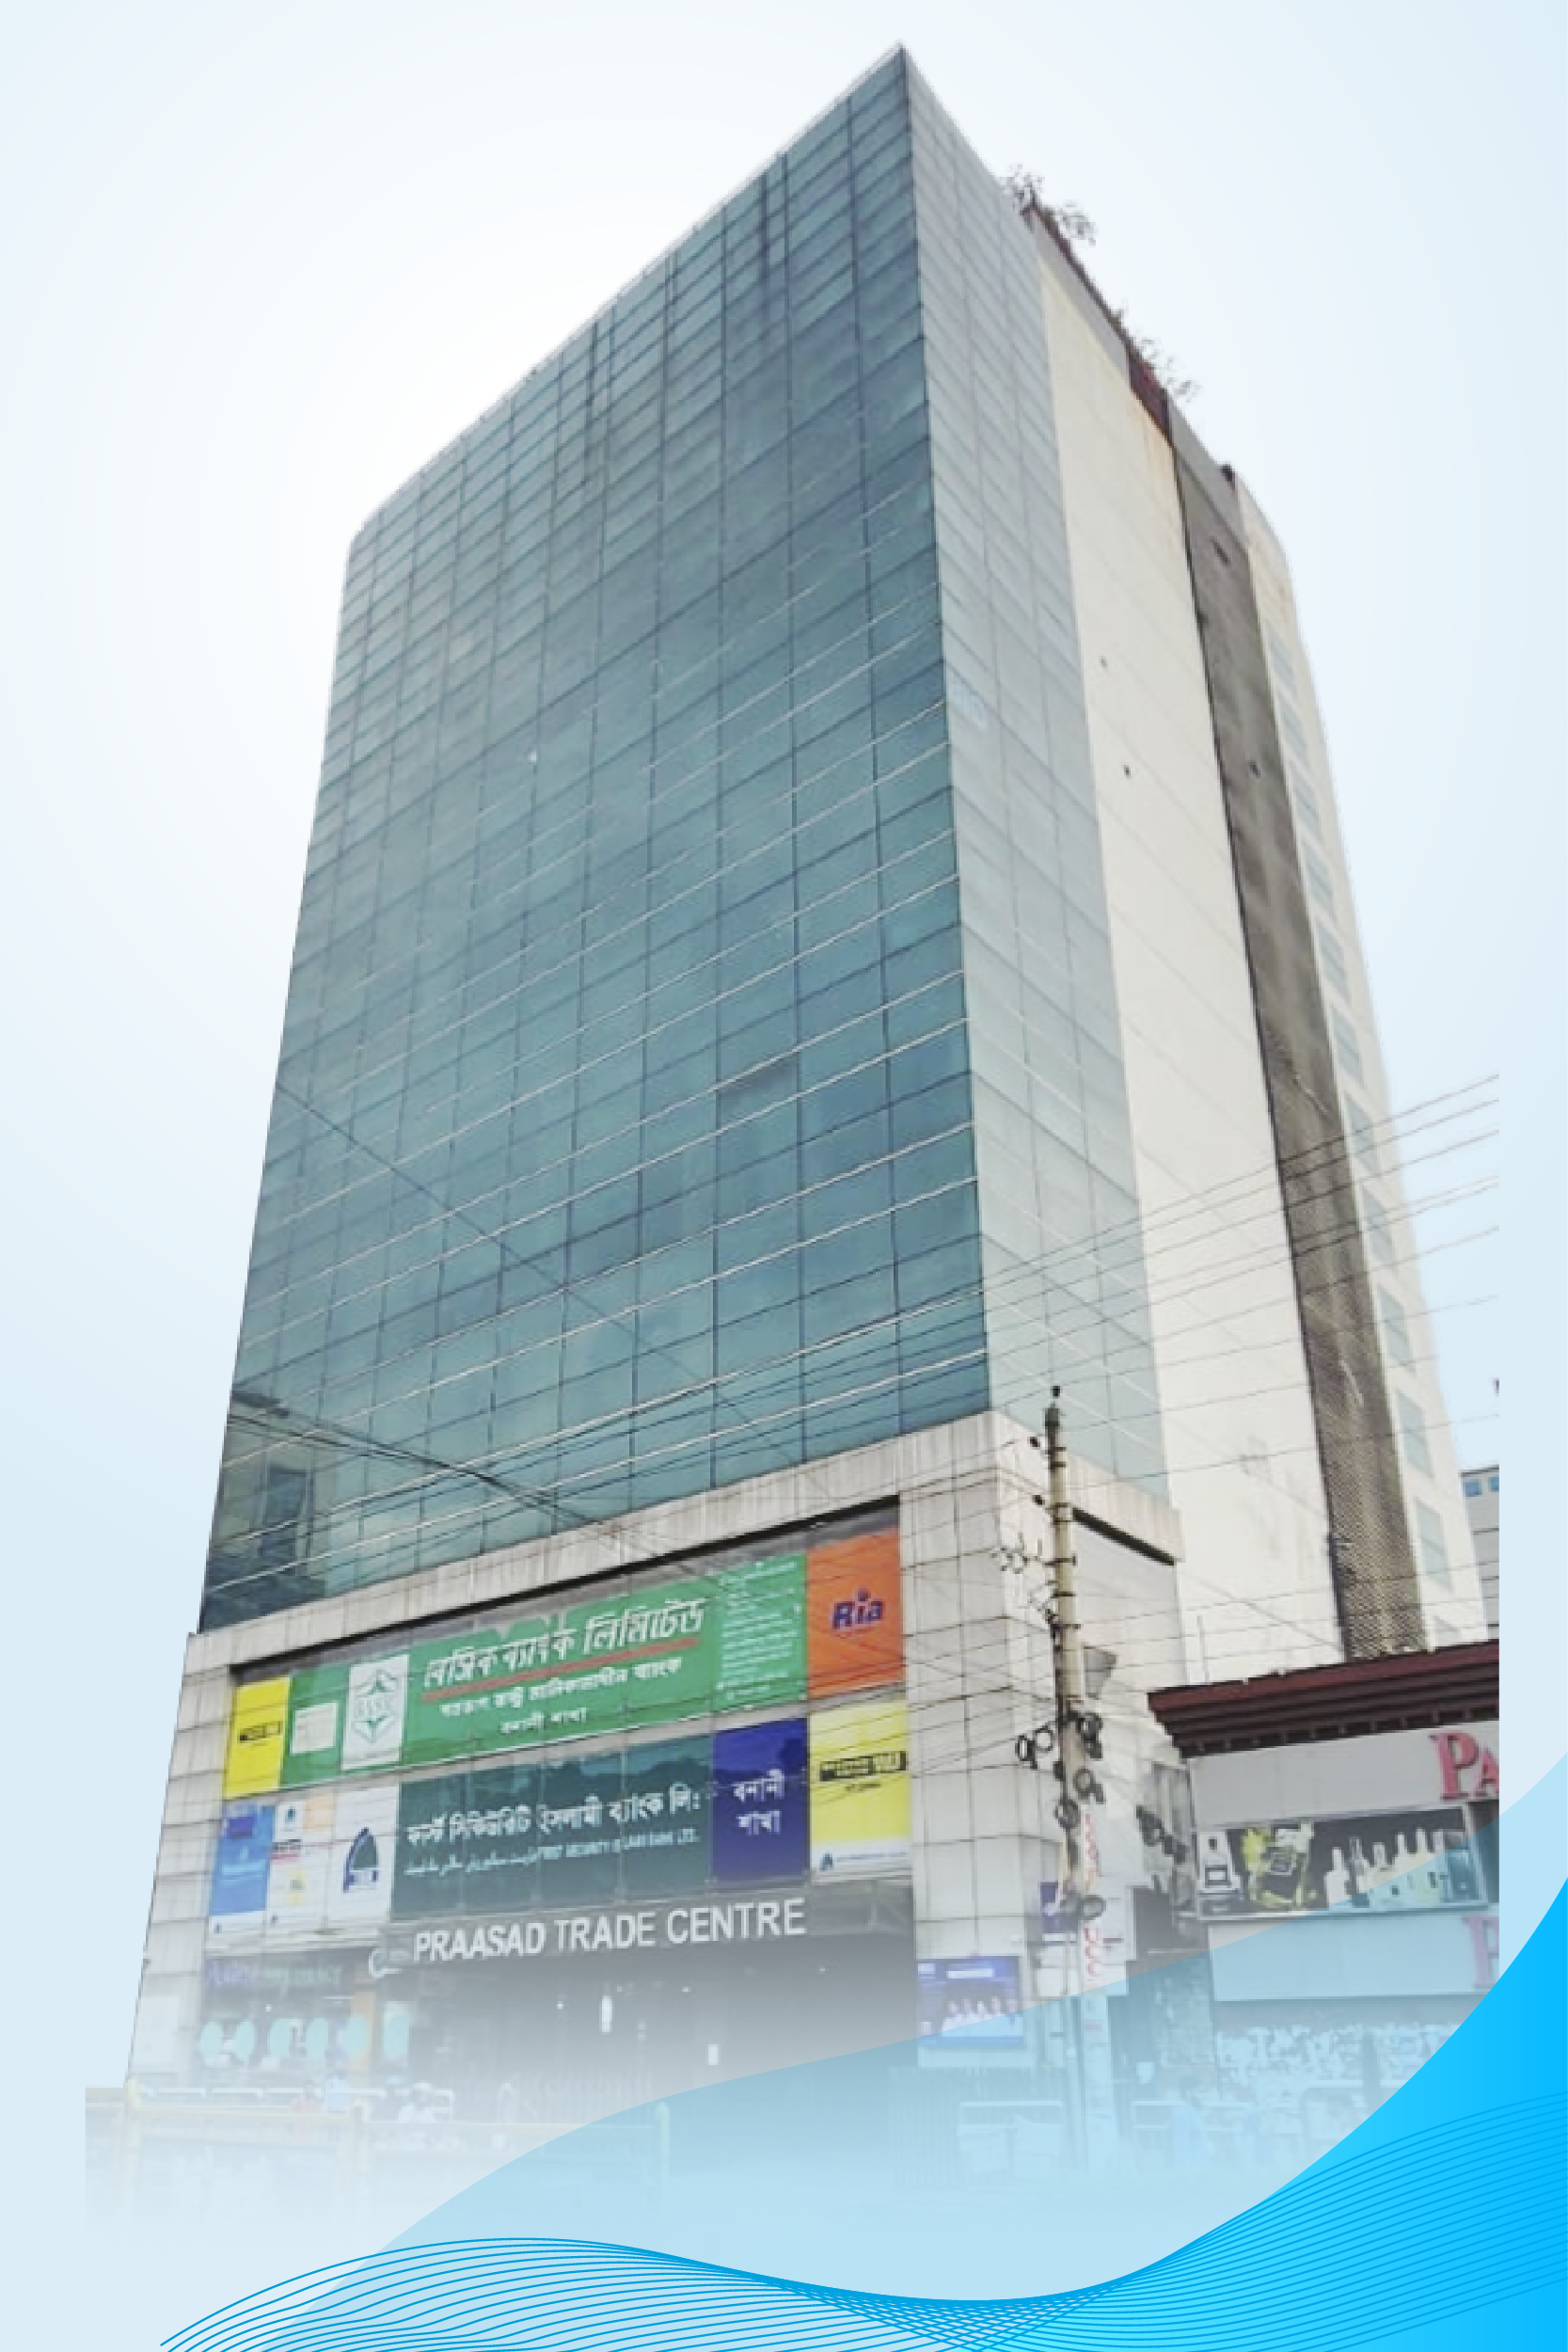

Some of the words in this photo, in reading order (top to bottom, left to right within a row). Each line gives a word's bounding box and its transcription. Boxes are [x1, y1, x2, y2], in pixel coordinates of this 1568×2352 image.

[583, 1598, 707, 1653] লিমিটেড
[831, 1584, 884, 1630] Ria
[731, 1768, 785, 1804] বনানী
[736, 1809, 783, 1836] শাখা
[413, 1919, 546, 1963] PRAASAD
[555, 1911, 657, 1953] TRADE
[666, 1897, 807, 1945] CENTRE
